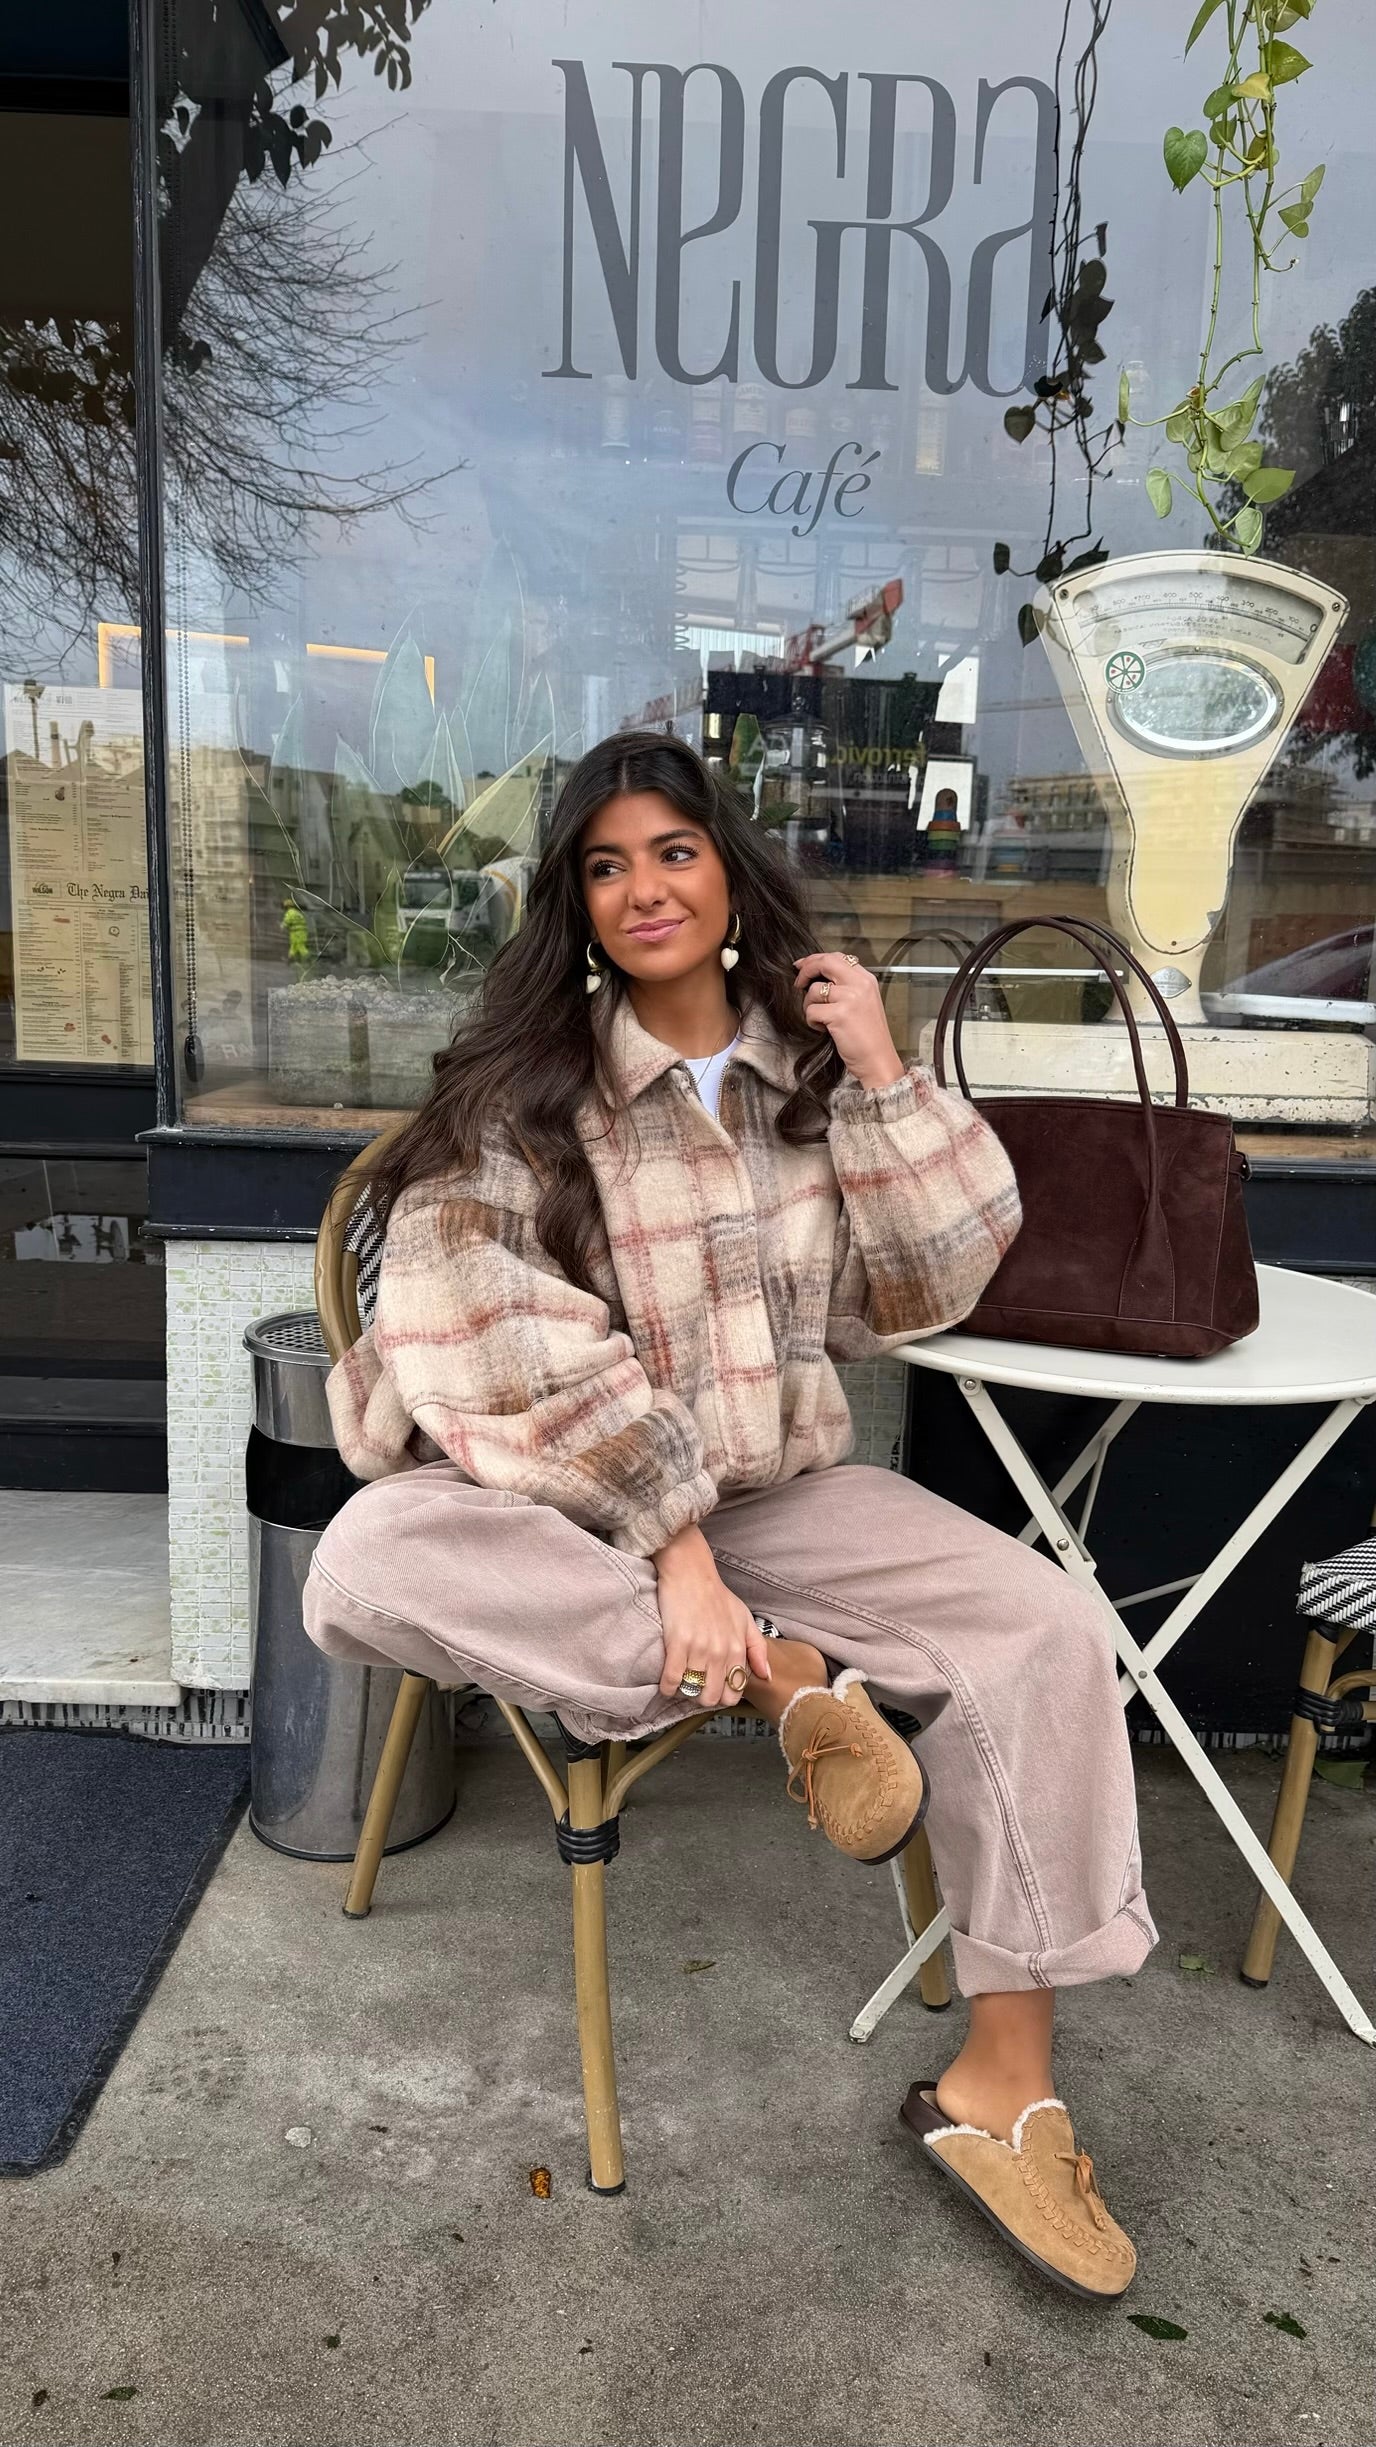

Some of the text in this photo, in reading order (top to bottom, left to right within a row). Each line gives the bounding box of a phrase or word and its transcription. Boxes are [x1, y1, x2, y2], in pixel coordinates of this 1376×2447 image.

[726, 441, 882, 538] Café
[66, 882, 89, 900] The
[91, 883, 126, 902] Negra
